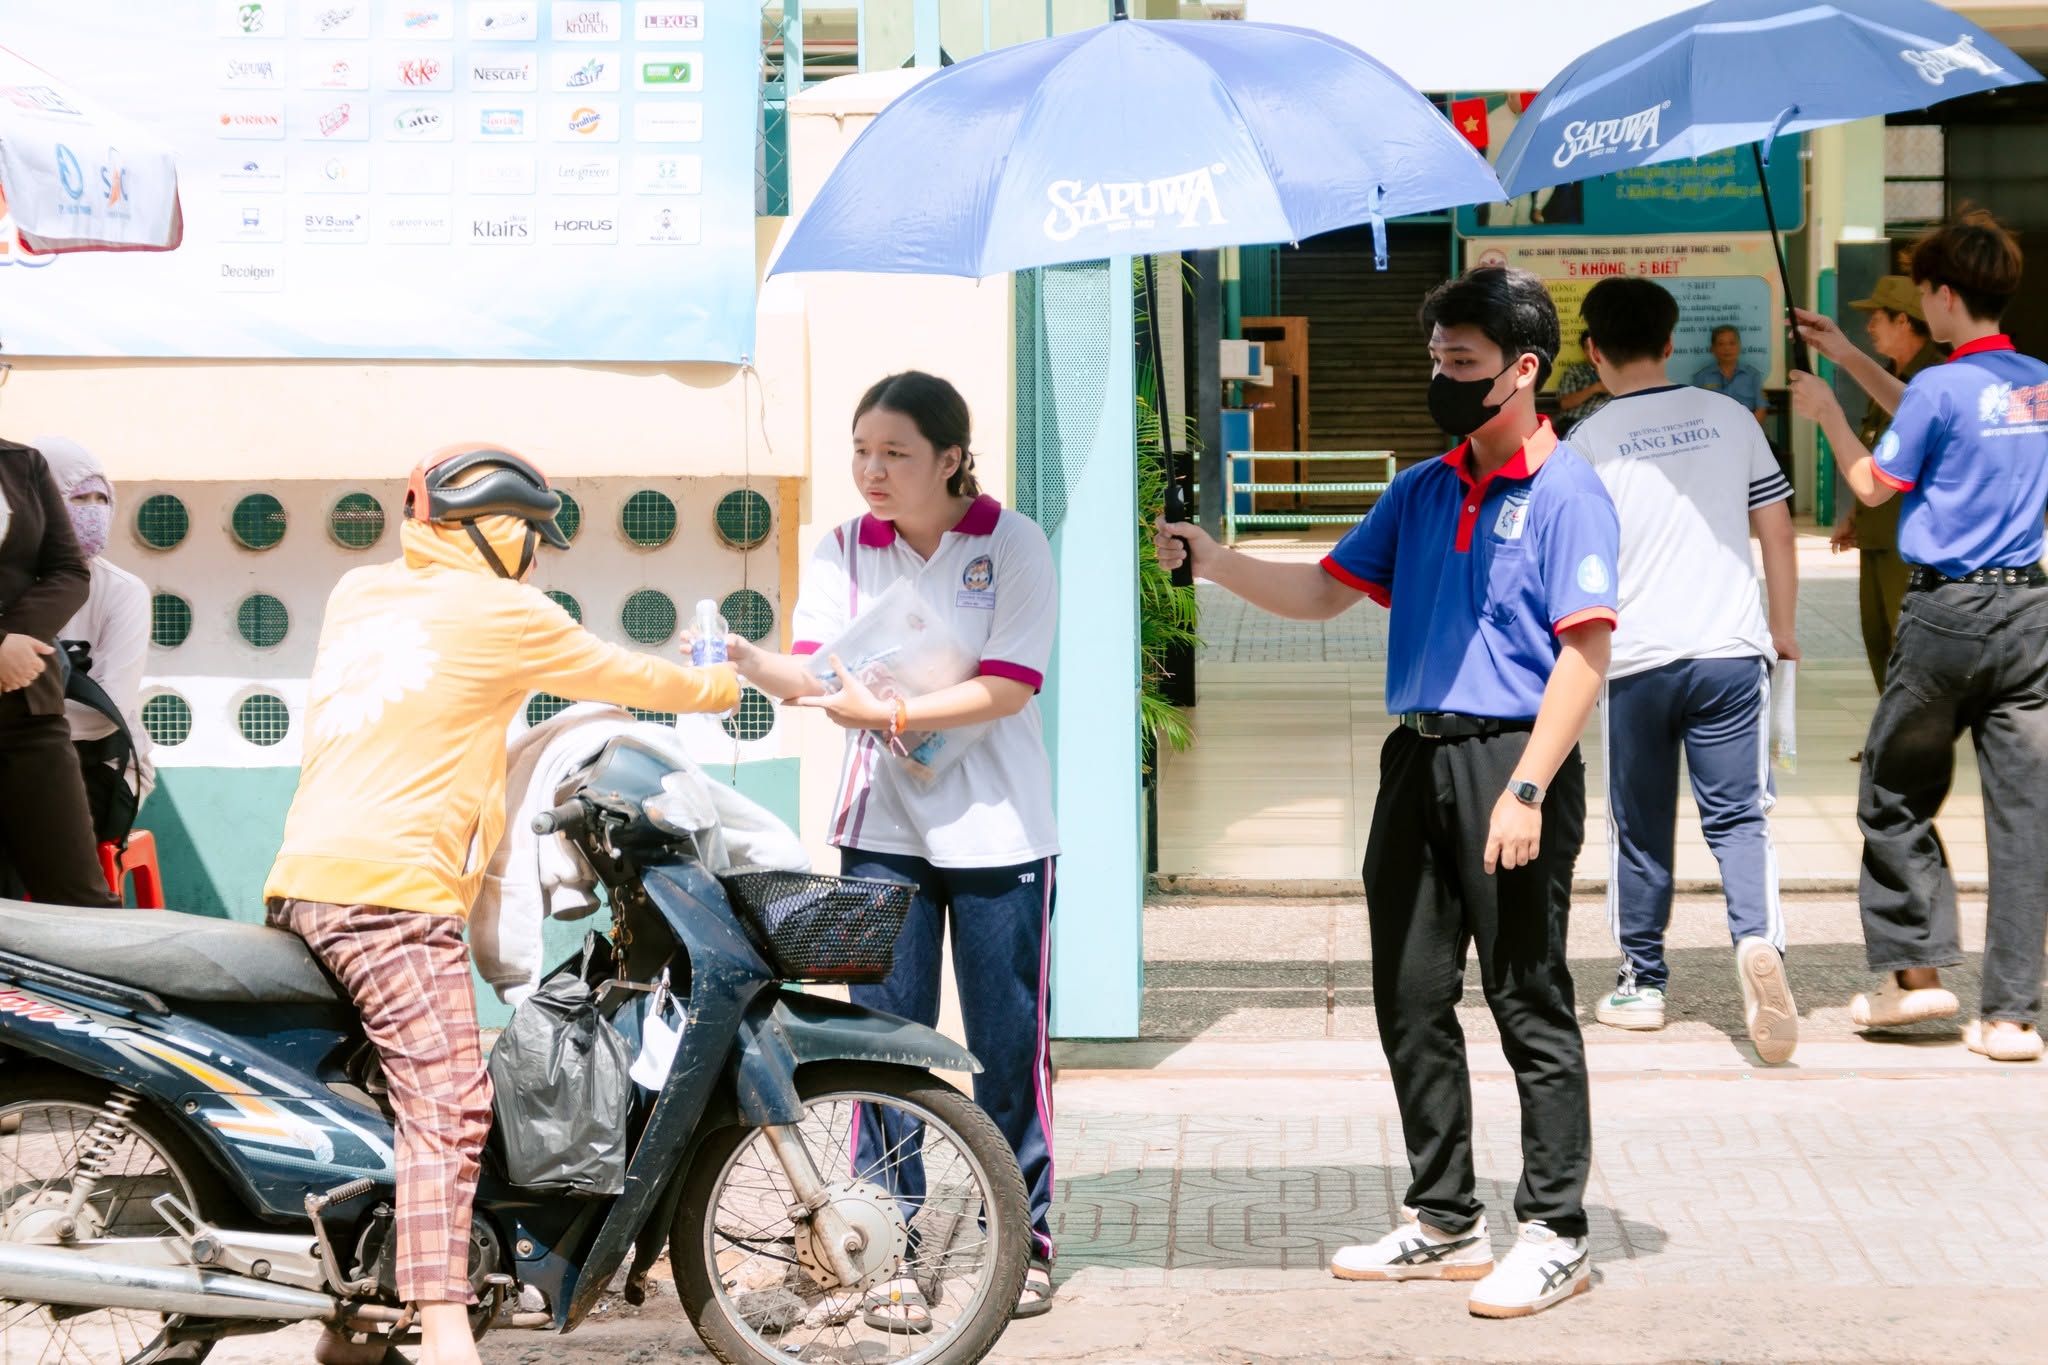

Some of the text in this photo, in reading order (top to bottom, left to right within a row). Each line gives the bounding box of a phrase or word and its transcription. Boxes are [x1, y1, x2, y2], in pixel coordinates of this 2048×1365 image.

[566, 17, 608, 34] krunch
[578, 10, 600, 24] oat
[646, 15, 697, 28] LEXUS
[226, 59, 273, 80] SAPUWA
[401, 58, 440, 86] KitKat
[234, 115, 278, 126] ORION
[1553, 103, 1661, 168] SAPUWA
[1043, 165, 1229, 241] SAPUWA
[305, 216, 355, 227] BVBank
[473, 220, 528, 237] Klairs
[554, 220, 612, 231] HORUS
[1536, 247, 1555, 256] SINH
[1591, 247, 1610, 255] THCS
[221, 264, 275, 280] Decolgen
[1581, 257, 1626, 276] KHÔNG
[1639, 261, 1648, 275] 5
[1618, 427, 1720, 456] ĐĂNG KHOA
